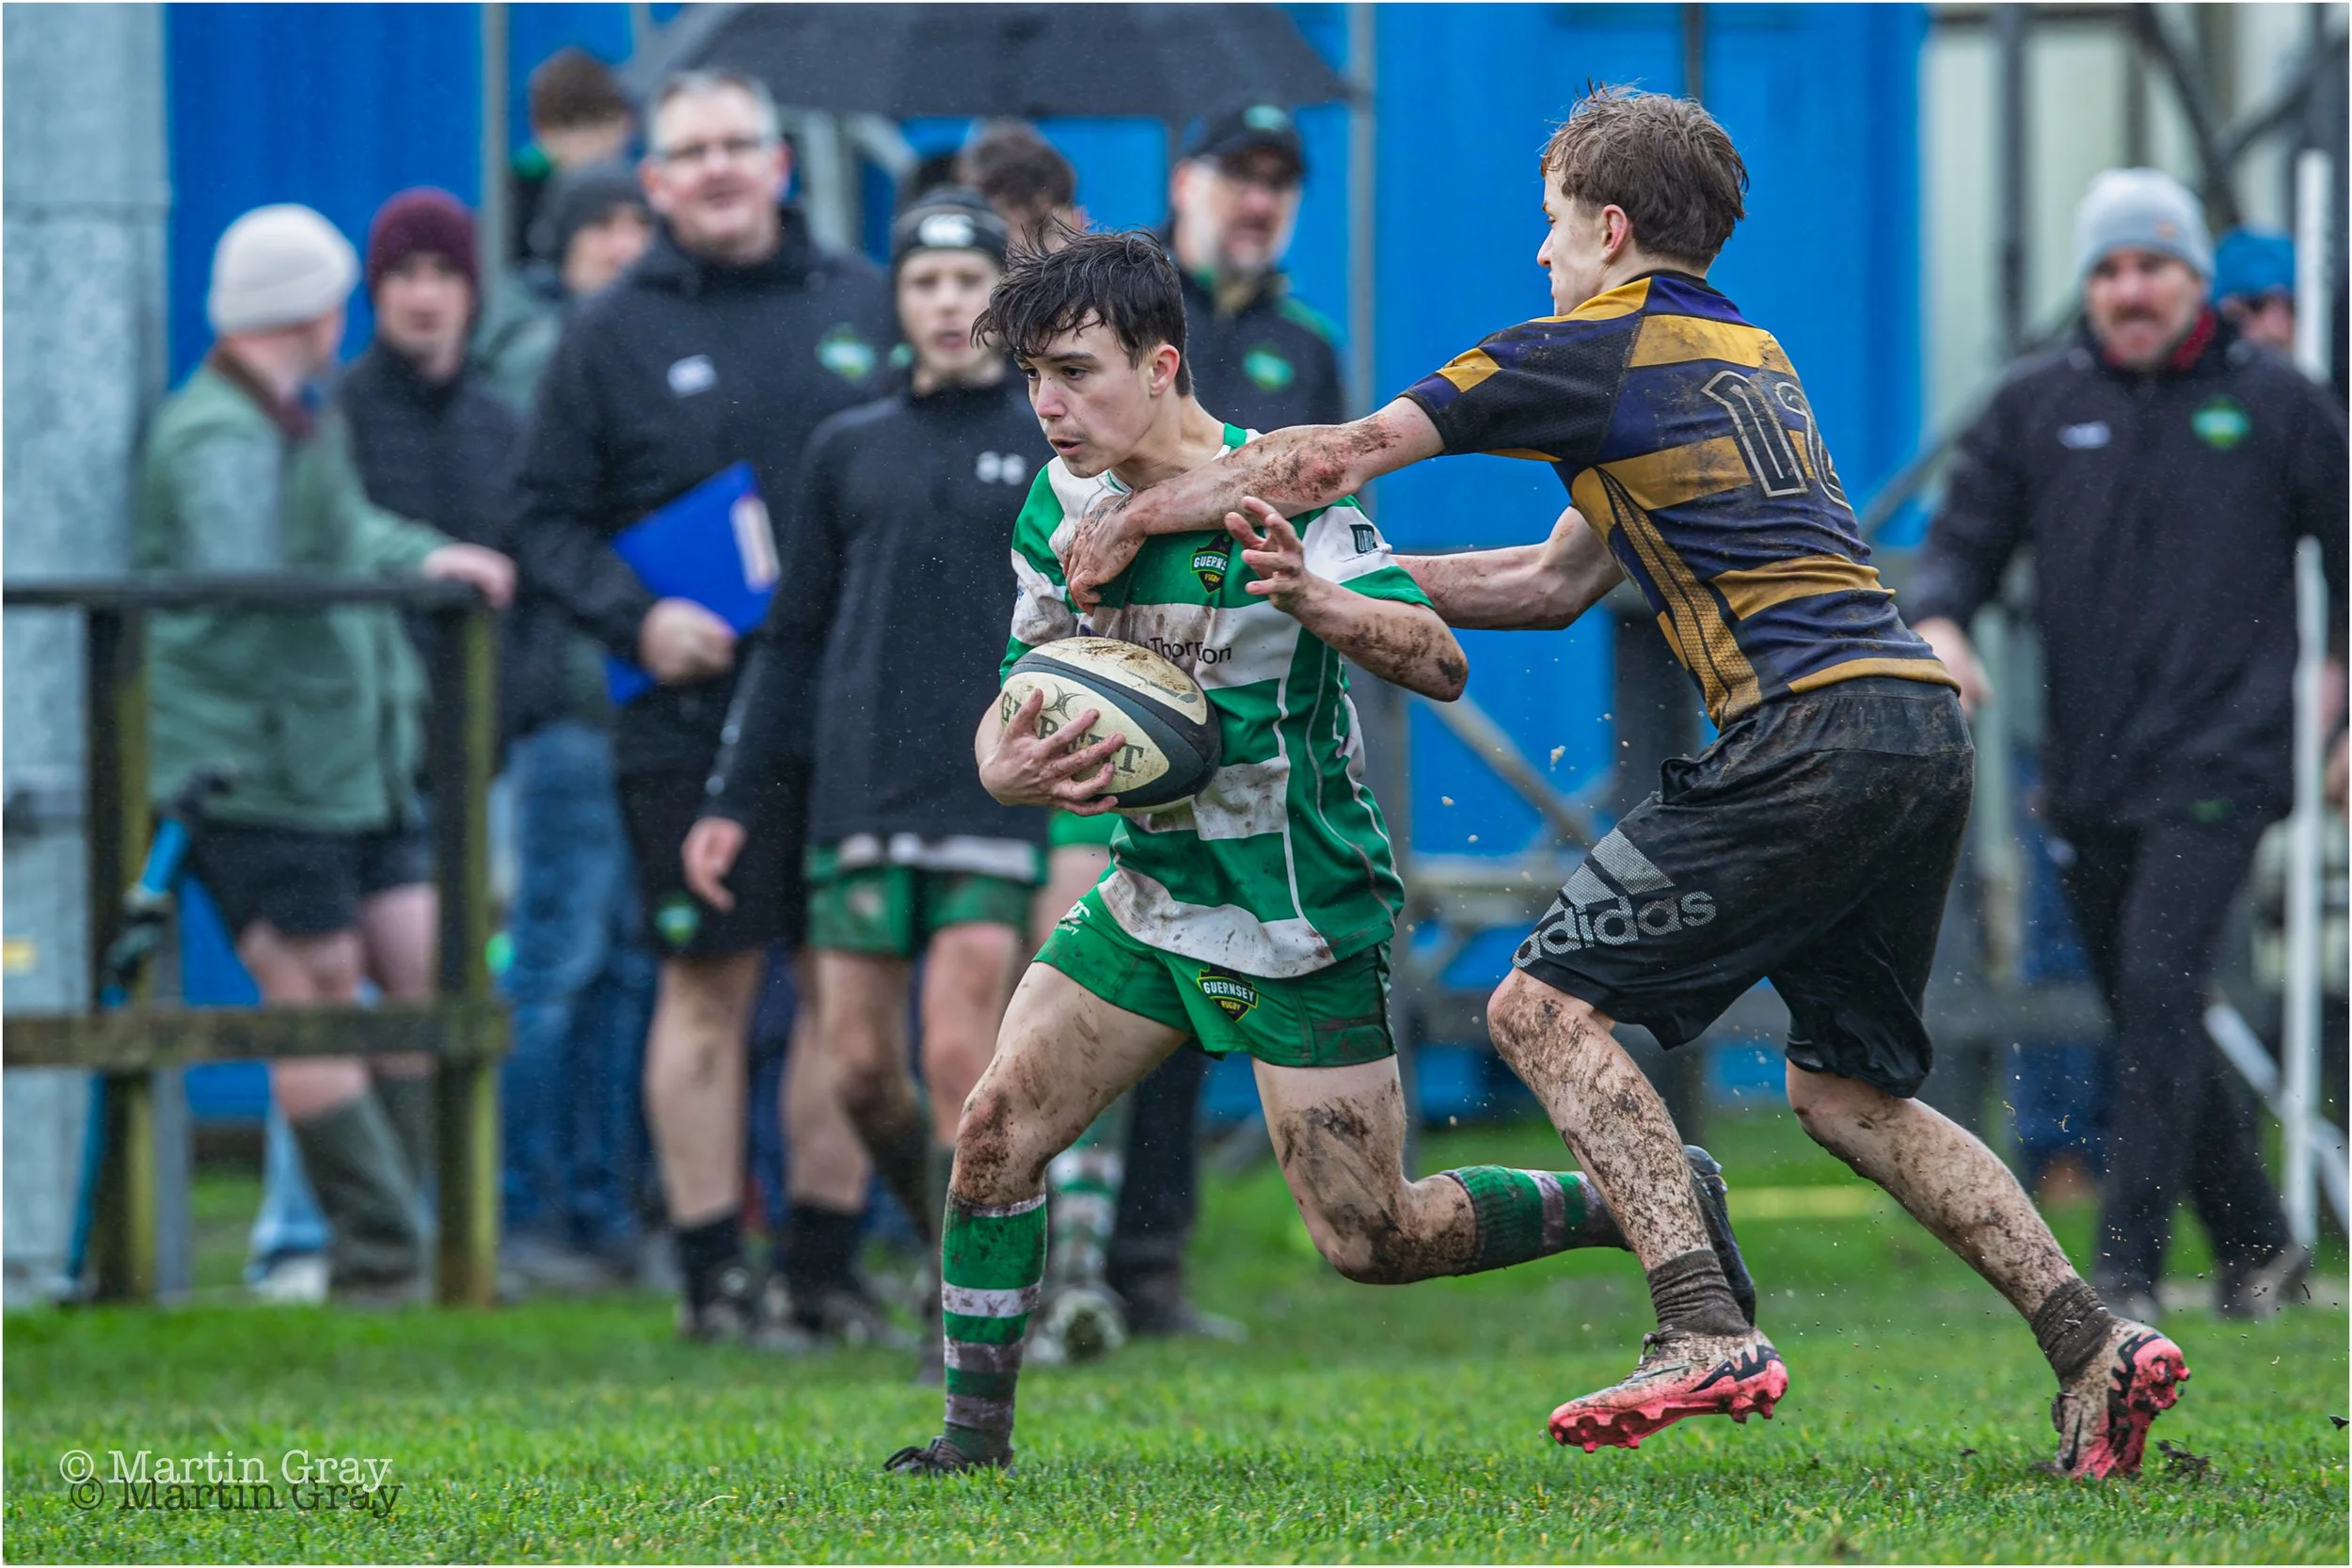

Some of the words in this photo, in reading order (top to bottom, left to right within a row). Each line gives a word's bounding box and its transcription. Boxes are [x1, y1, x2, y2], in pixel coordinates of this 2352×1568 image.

[1701, 370, 1853, 511] 12
[1193, 556, 1228, 571] GUERNS
[1150, 637, 1232, 664] Thoron
[1510, 891, 1717, 968] adidas
[1202, 981, 1255, 1002] GUERNSEY
